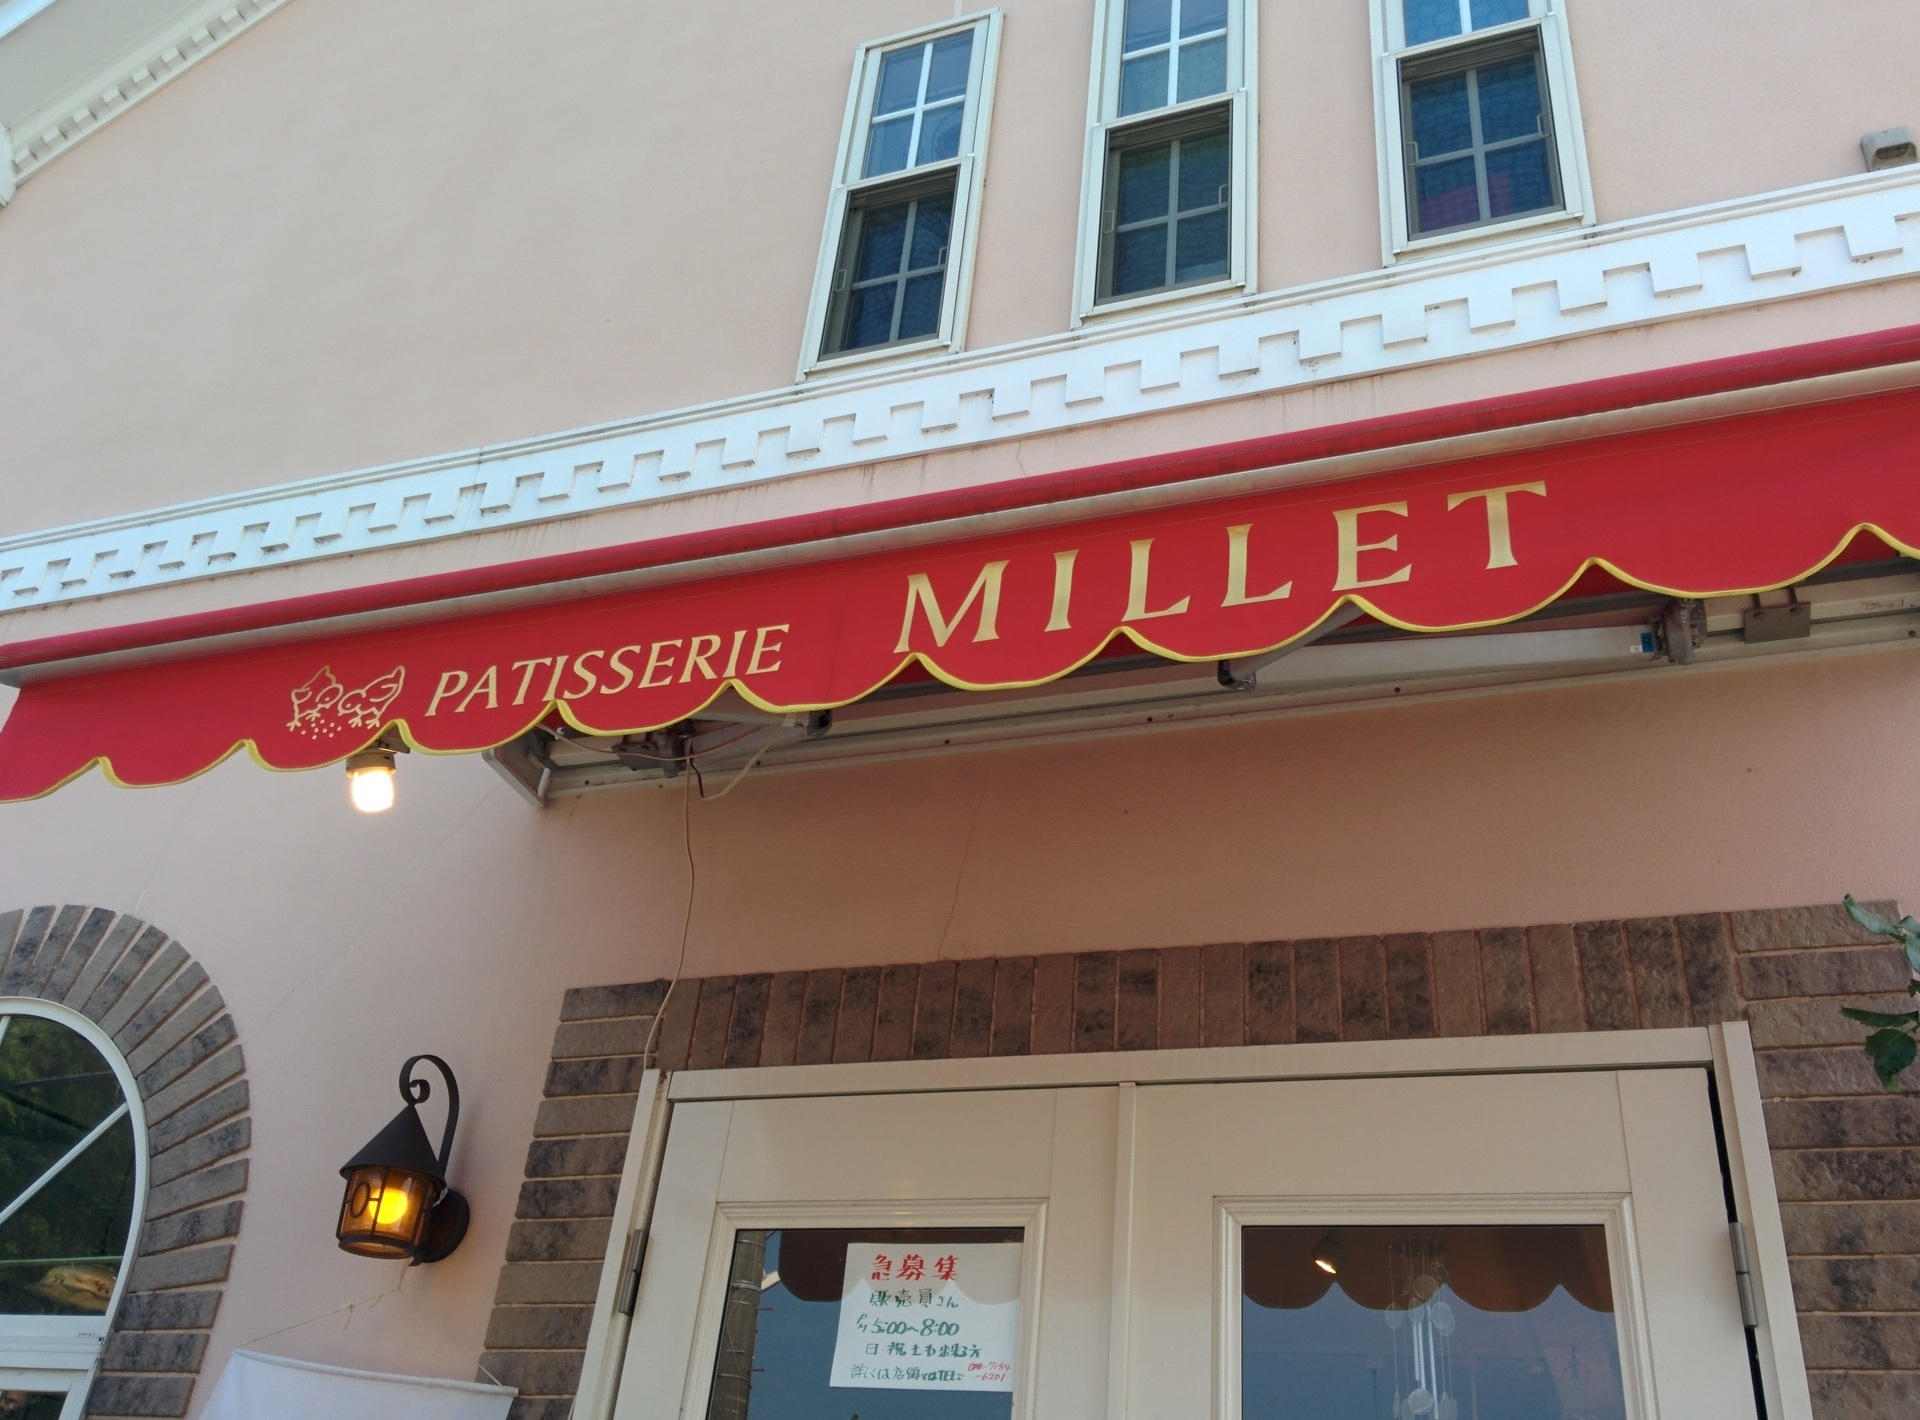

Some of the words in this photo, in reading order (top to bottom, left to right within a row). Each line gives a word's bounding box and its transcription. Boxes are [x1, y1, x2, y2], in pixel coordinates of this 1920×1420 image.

[424, 623, 790, 717] PATISSERIE
[893, 480, 1547, 654] MILLET
[871, 1254, 960, 1281] 急募集
[869, 1288, 960, 1308] 販売員さん
